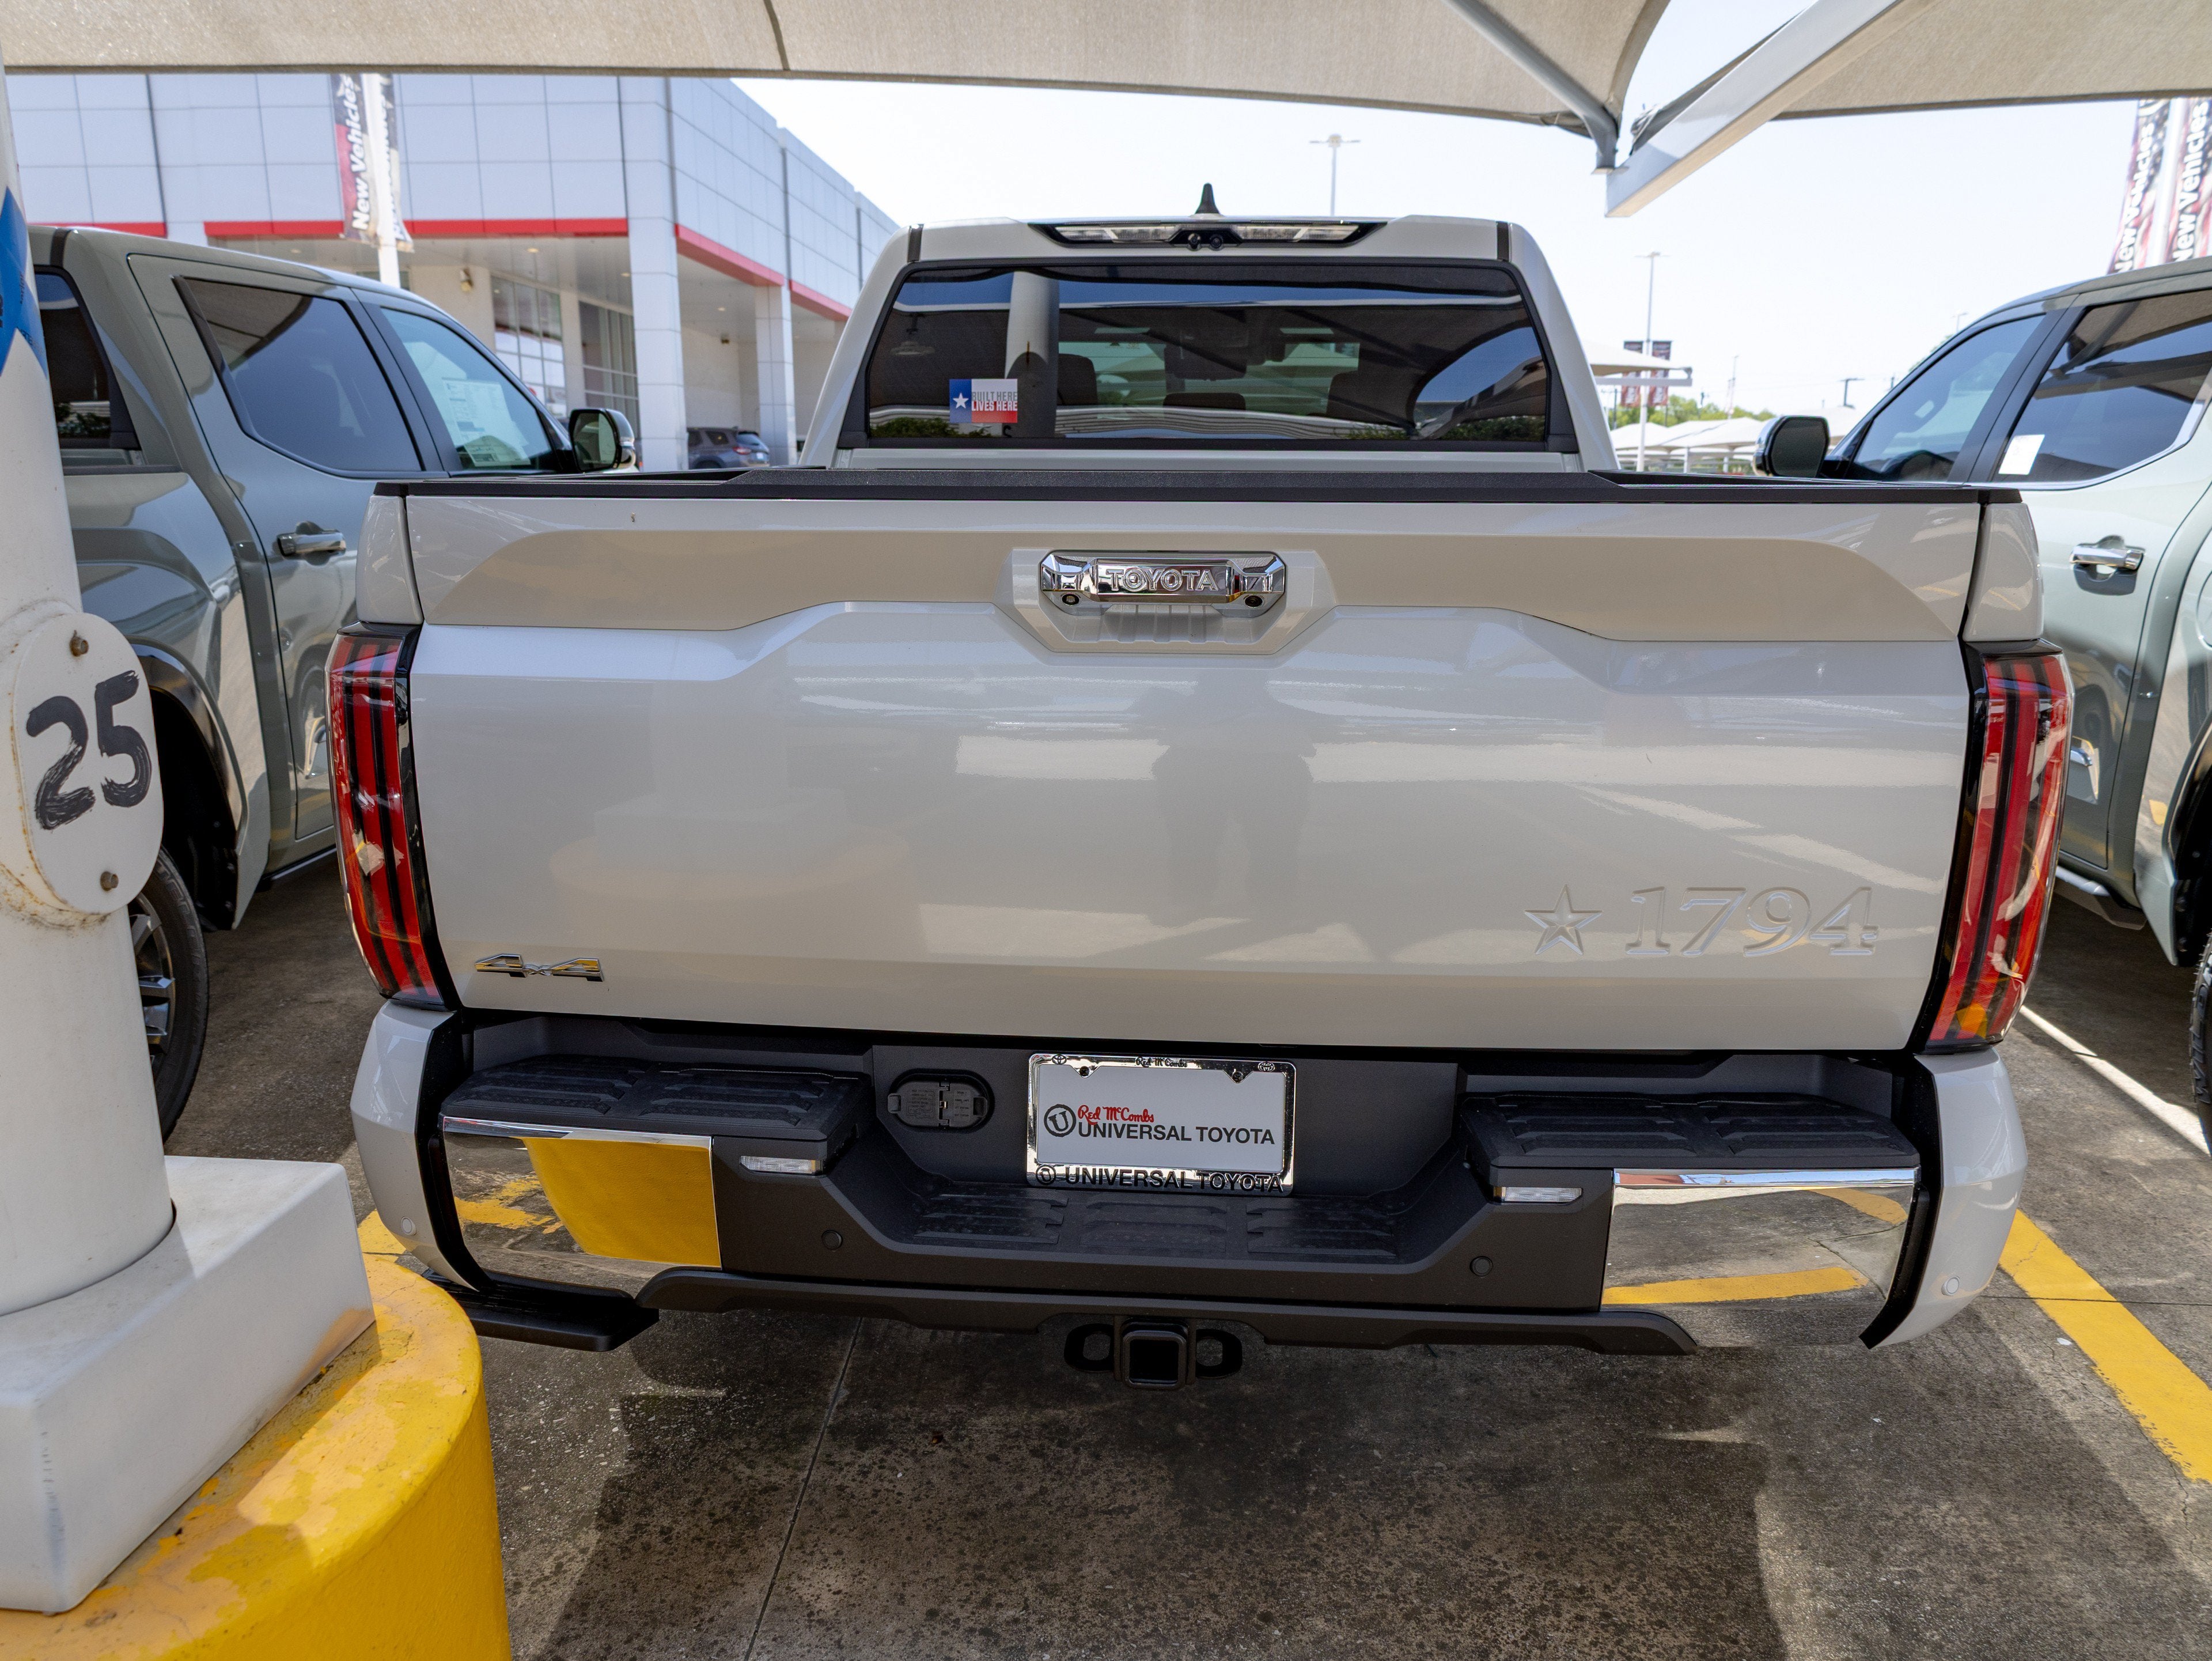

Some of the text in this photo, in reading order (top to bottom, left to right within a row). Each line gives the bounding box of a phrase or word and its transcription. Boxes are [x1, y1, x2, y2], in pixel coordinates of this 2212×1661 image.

[342, 74, 370, 230] New Vehicles
[2179, 101, 2210, 213] Vehicles
[972, 391, 1018, 402] BUILT HERE
[972, 401, 1018, 411] LIVES HERE
[1106, 567, 1218, 592] TOYOTA
[26, 670, 152, 831] 25
[1625, 886, 1878, 958] 1794
[1136, 1055, 1187, 1068] Red McCombs
[1078, 1104, 1154, 1125] Red McCombs
[1078, 1122, 1275, 1145] UNIVERSAL TOYOTA
[1065, 1166, 1283, 1193] UNIVERSAL TOYOTA
